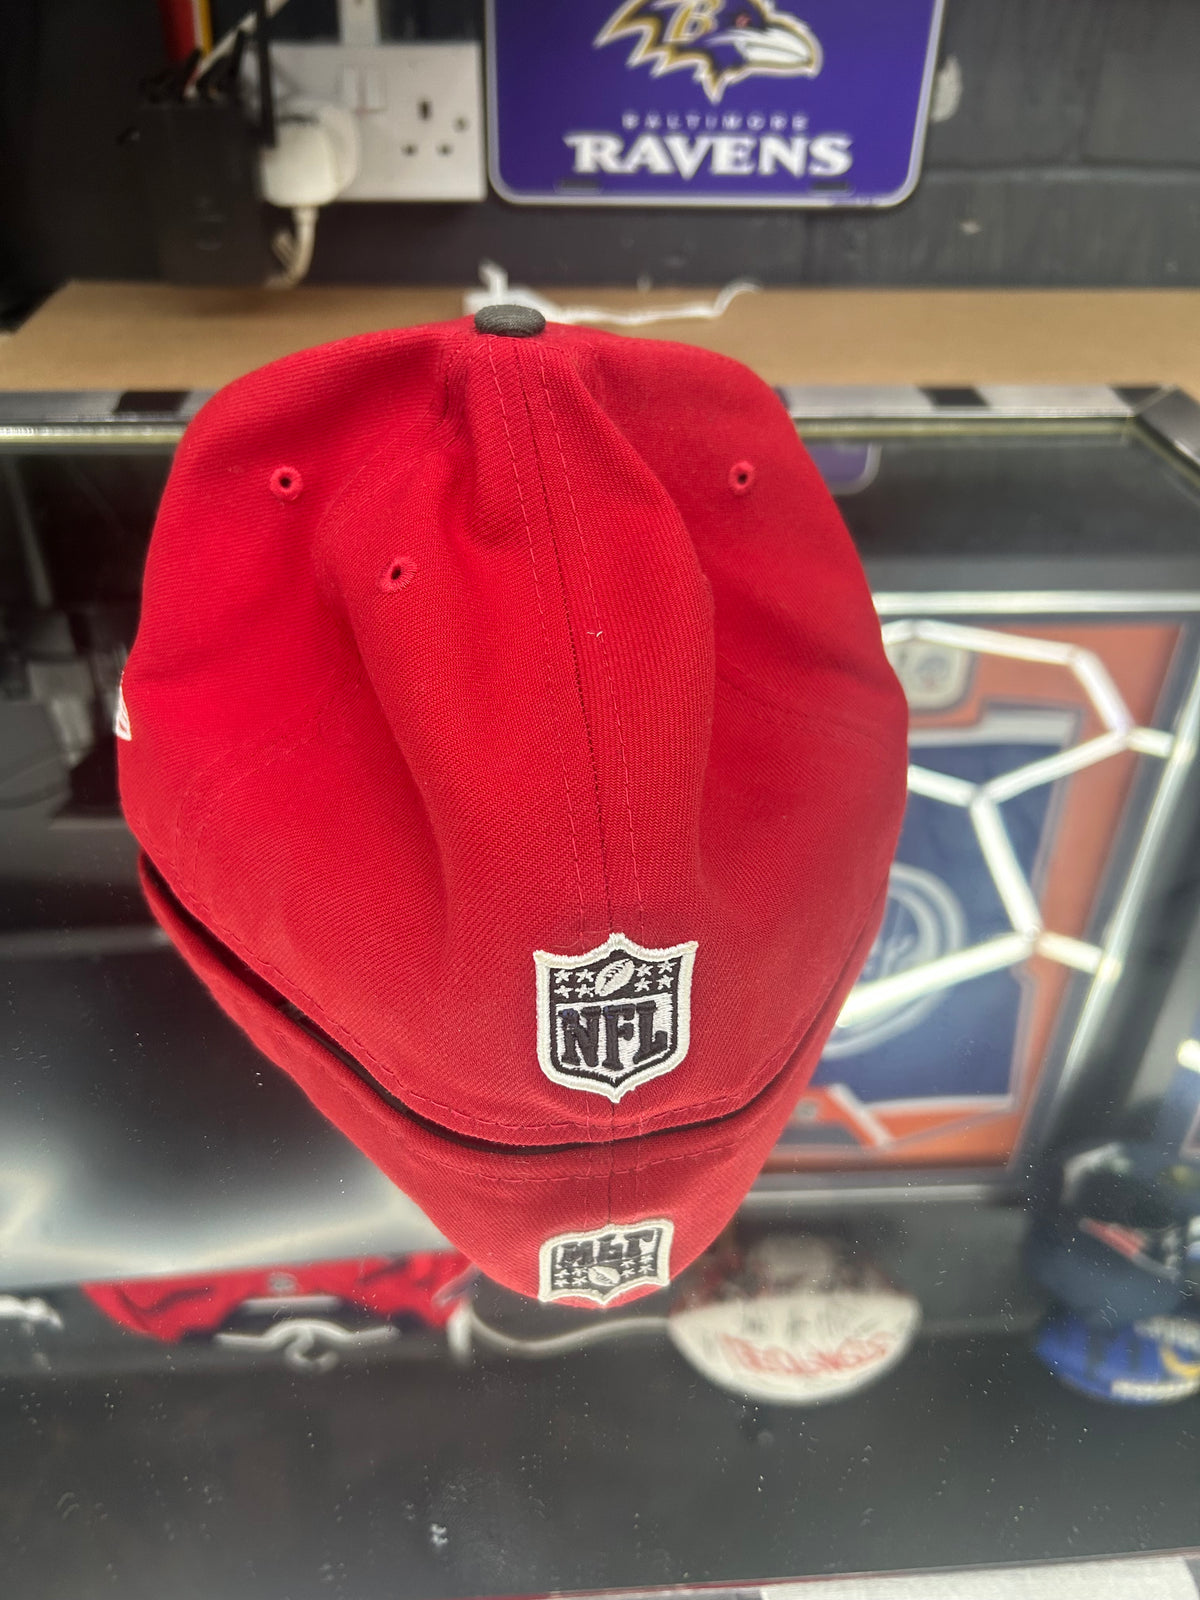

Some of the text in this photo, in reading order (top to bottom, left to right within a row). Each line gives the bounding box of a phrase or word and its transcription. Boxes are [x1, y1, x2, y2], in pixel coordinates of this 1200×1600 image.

[622, 113, 809, 131] BALTIMORE
[562, 132, 853, 180] RAVENS
[558, 1000, 668, 1071] NFL
